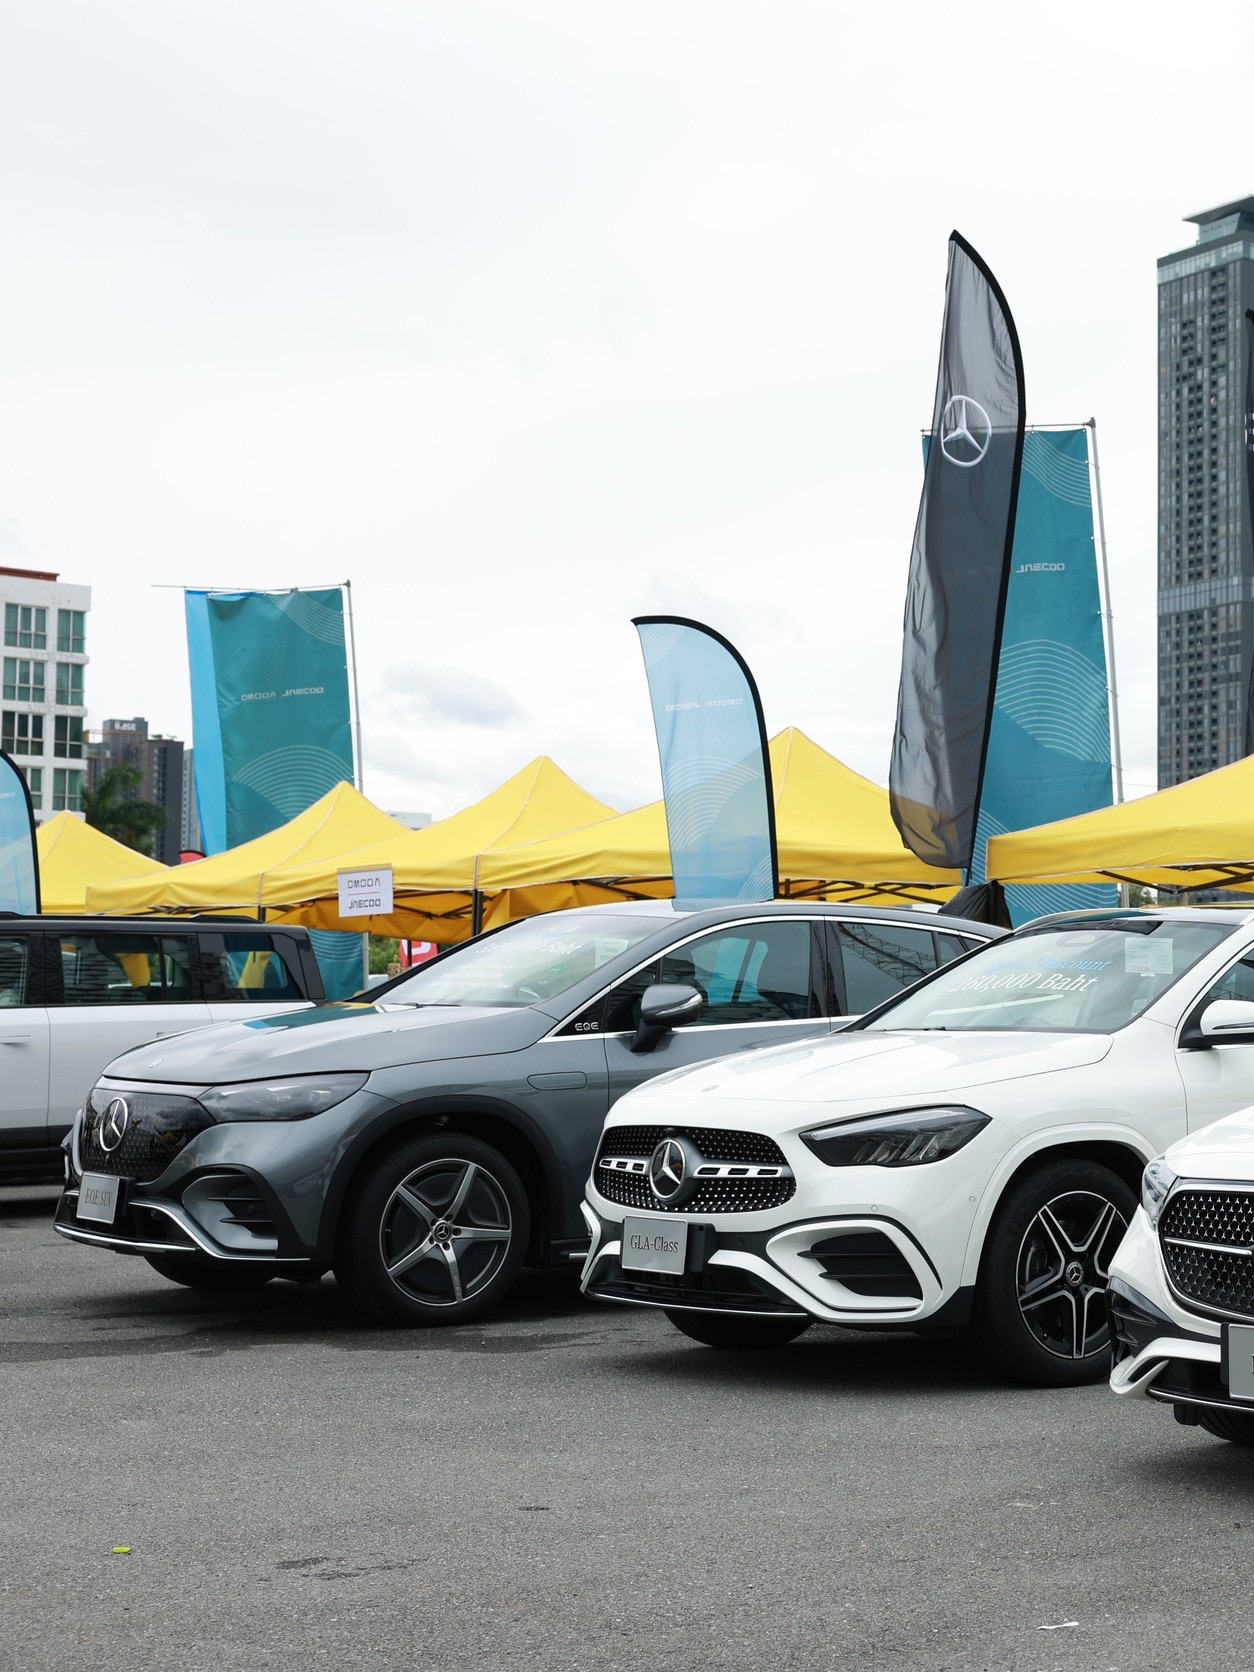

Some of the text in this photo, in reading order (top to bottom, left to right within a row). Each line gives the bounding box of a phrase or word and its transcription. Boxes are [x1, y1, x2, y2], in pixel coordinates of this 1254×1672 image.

[1015, 562, 1065, 574] JAECOO
[241, 686, 324, 702] OMODA JAECOO
[347, 877, 381, 889] OMODA
[348, 898, 381, 910] JAECOO
[1036, 974, 1098, 992] Baht
[574, 1021, 599, 1031] EQE
[630, 1234, 679, 1253] GLA-Class
